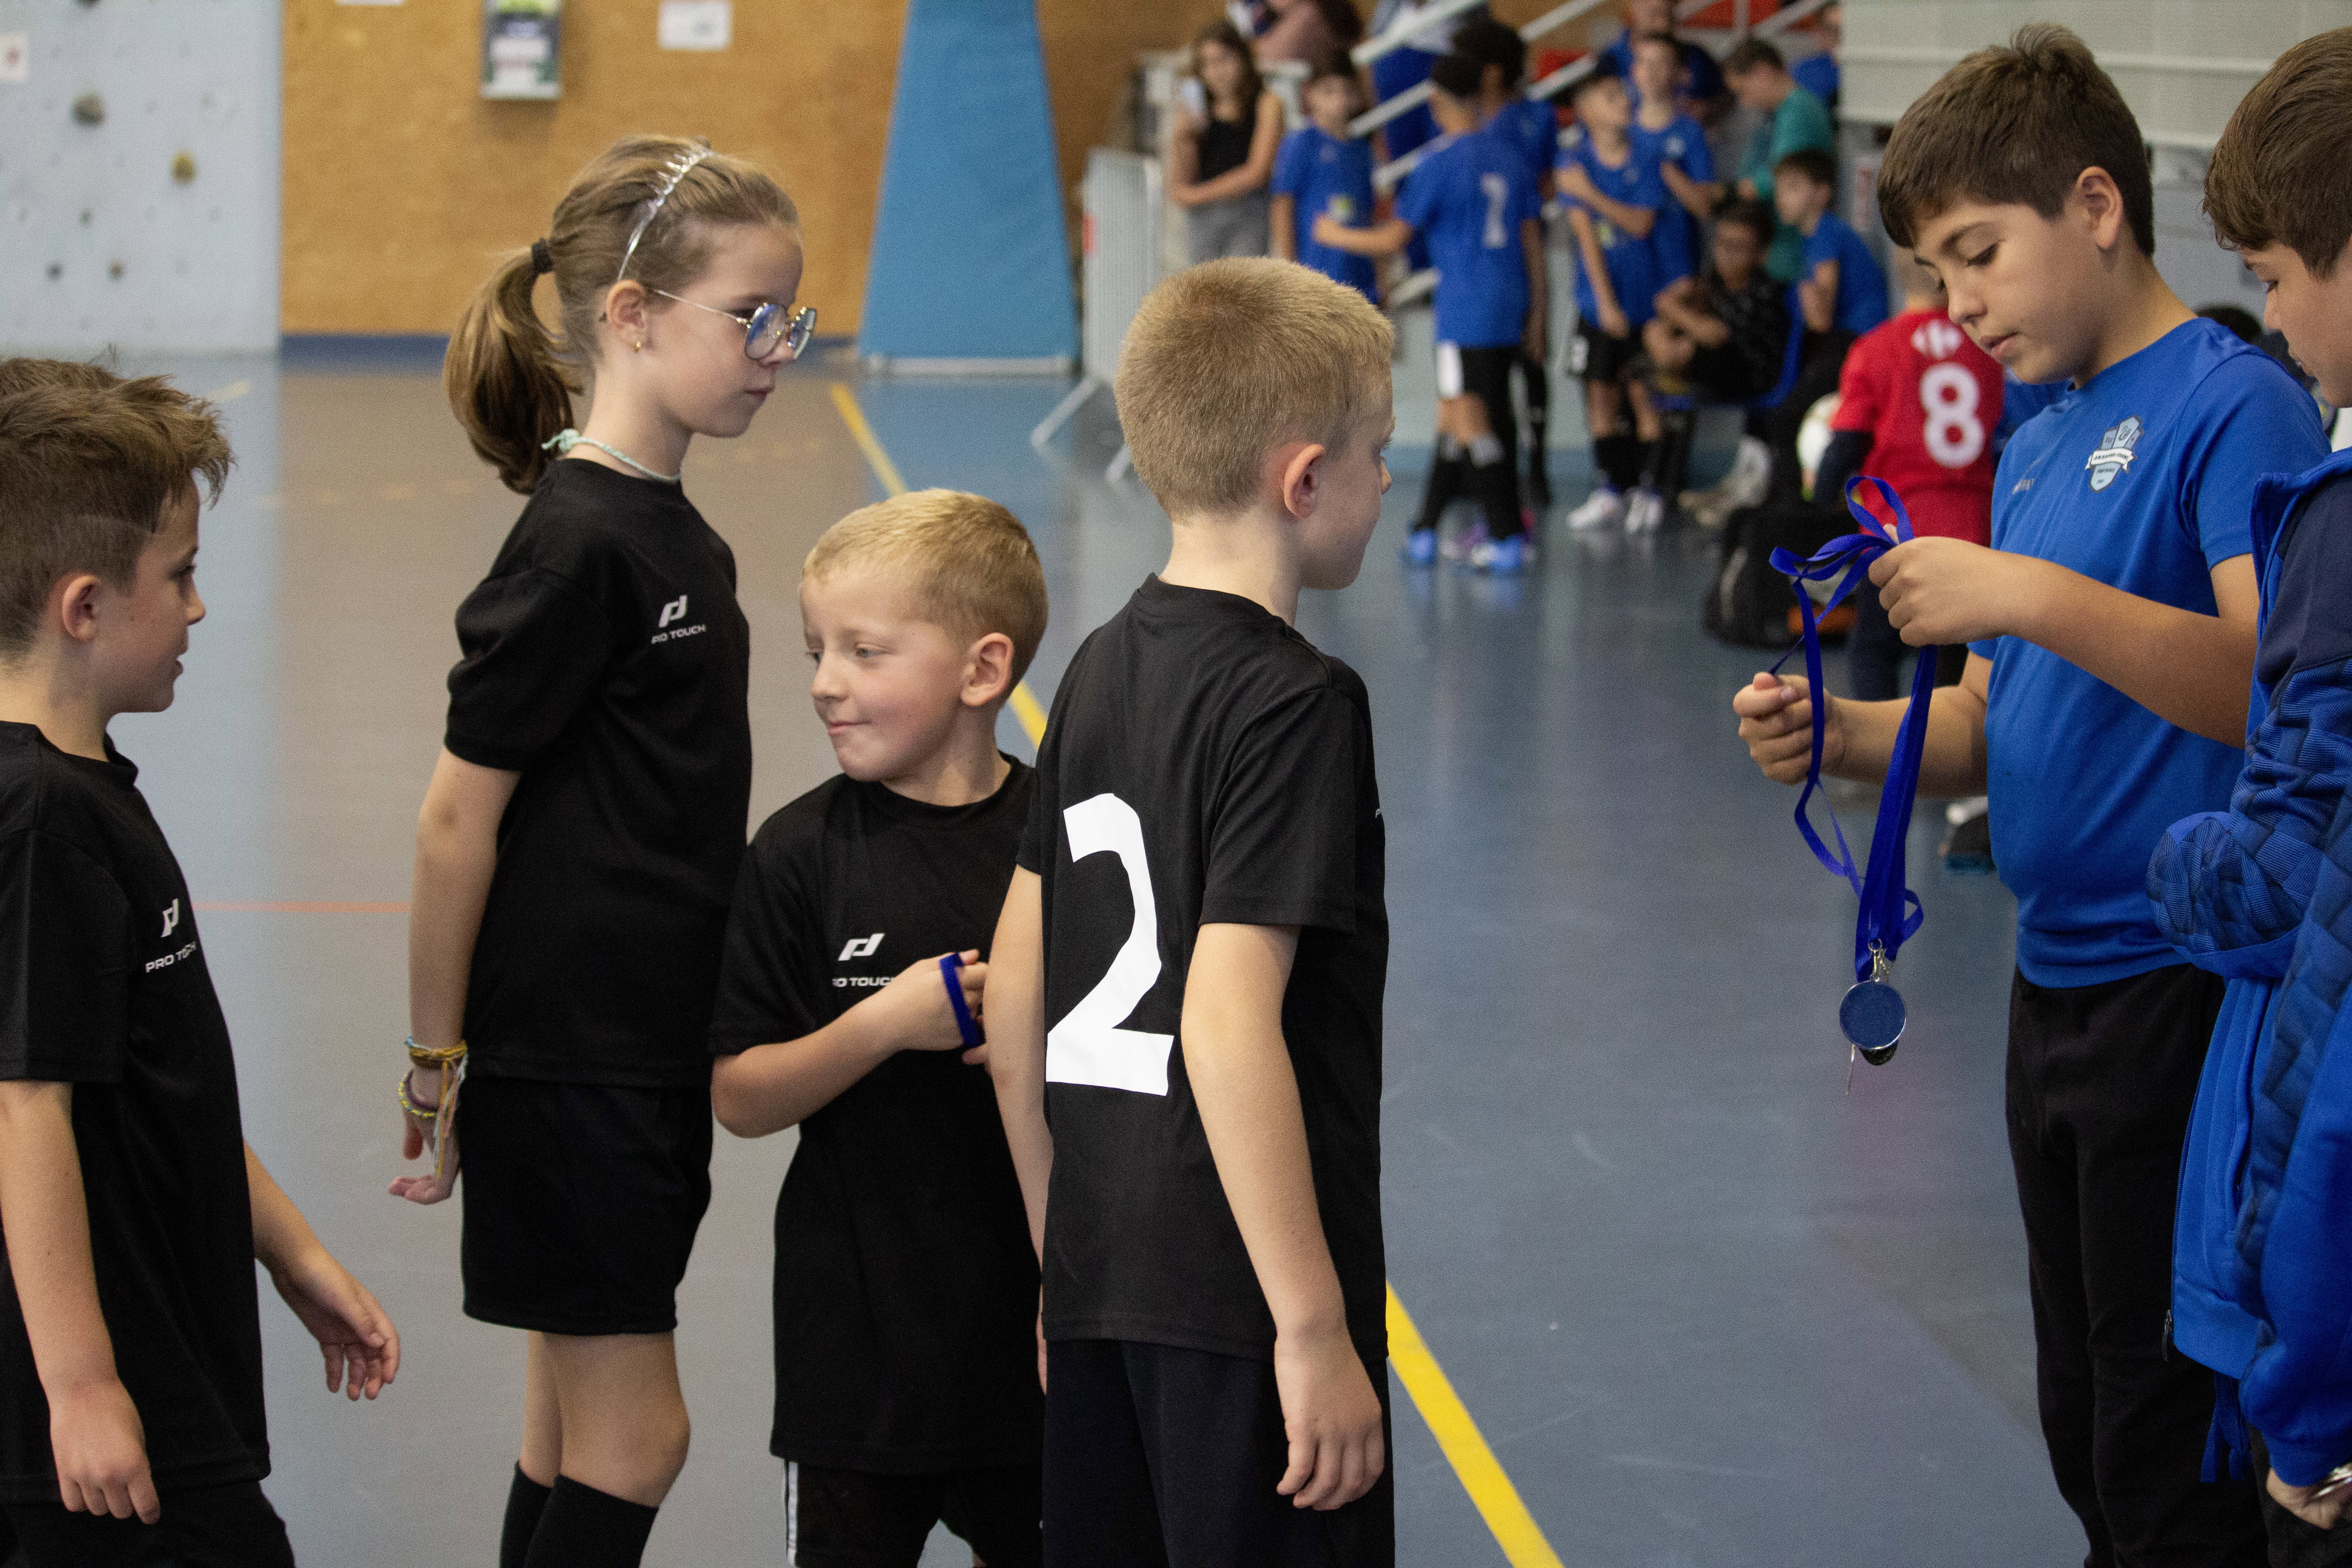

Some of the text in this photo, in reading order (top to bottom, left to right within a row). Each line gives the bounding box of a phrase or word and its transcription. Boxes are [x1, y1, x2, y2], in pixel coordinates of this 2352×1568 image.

[1920, 362, 1985, 468] 8
[145, 954, 174, 973] PRO
[1045, 793, 1174, 1097] 2
[849, 976, 896, 986] TOUC
